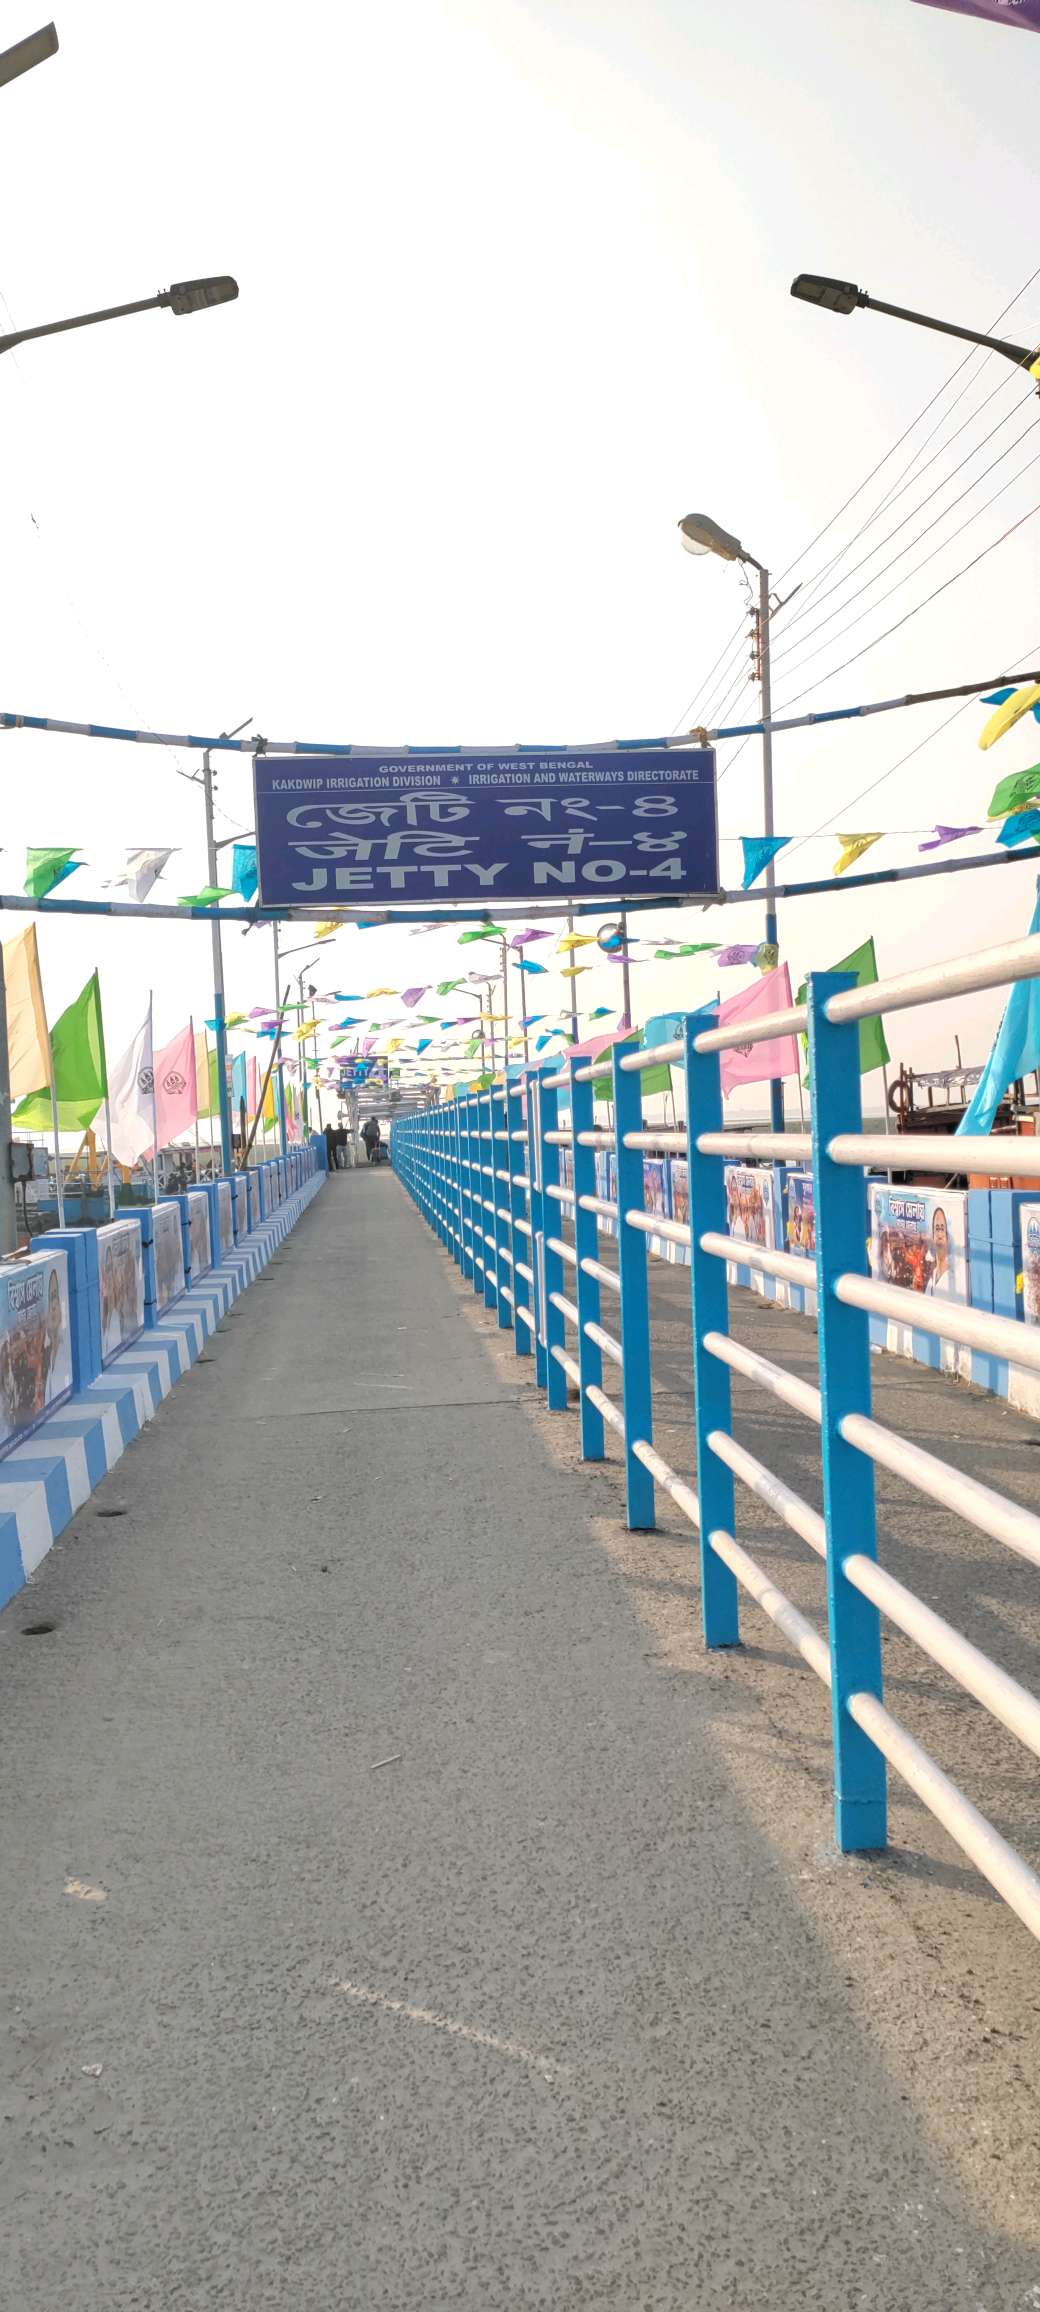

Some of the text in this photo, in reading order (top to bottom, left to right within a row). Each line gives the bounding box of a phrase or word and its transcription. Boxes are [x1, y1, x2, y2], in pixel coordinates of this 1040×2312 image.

[379, 761, 593, 773] GOVERNMENT OF WEST BENGAL
[468, 769, 699, 785] IRRIGATION AND WATERWAYS DIRECTORATE
[272, 774, 441, 790] KAKDWIP IRRIGATION DIVISION
[286, 791, 679, 829] জেটি নং-৪
[287, 830, 480, 861] जेटि
[291, 858, 687, 891] JETTY NO-4
